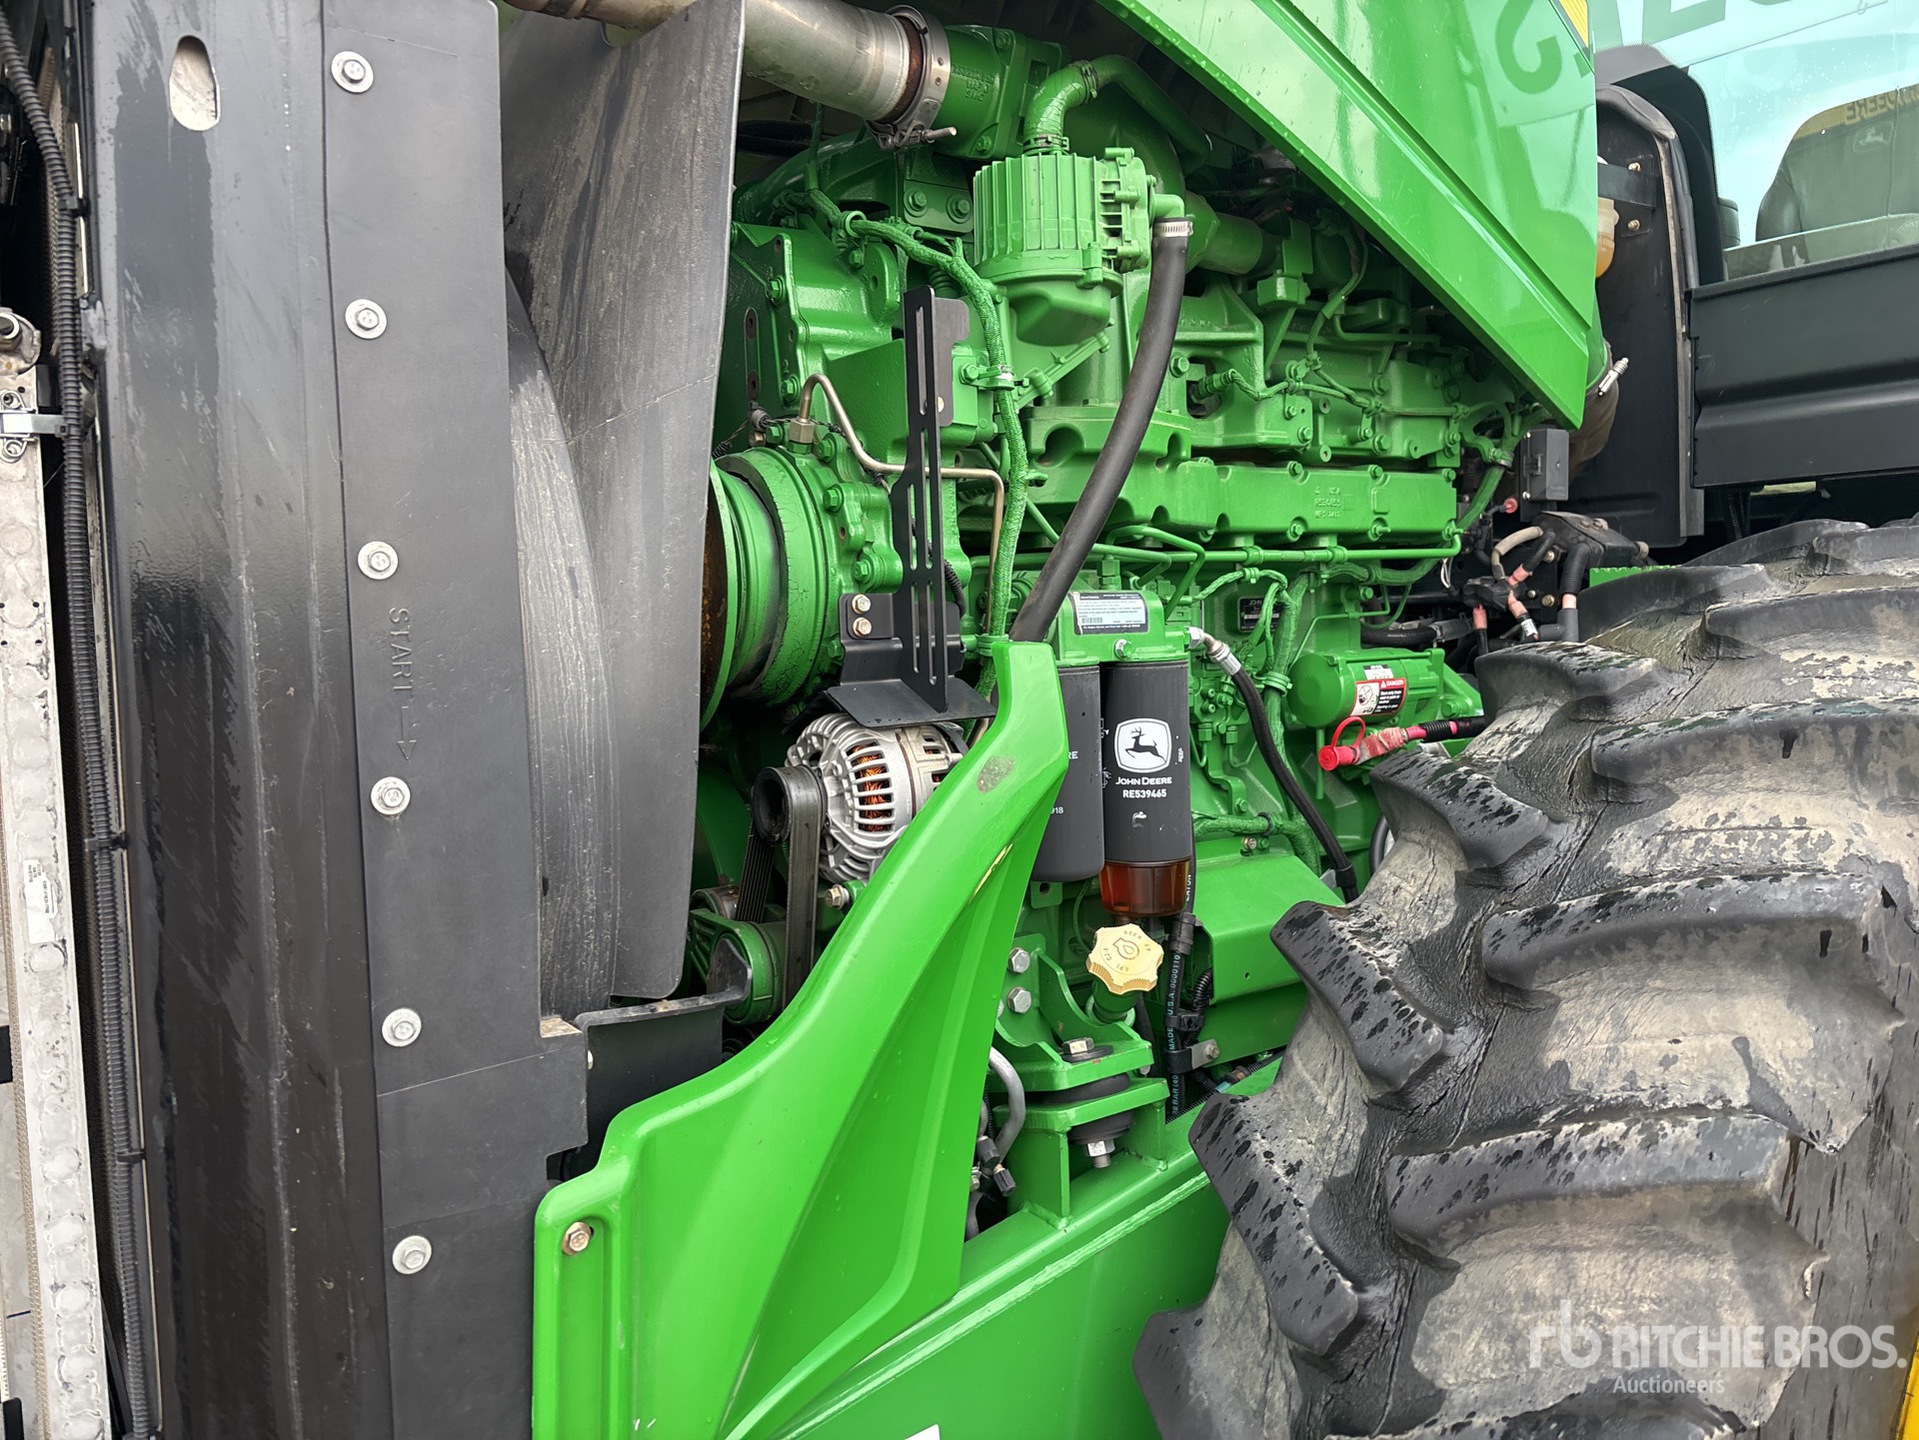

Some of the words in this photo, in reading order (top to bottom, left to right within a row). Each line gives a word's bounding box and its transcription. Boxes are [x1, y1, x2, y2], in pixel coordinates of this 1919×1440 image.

[388, 607, 415, 702] START
[1115, 776, 1141, 785] JOHN
[1141, 776, 1173, 786] DEERE
[1122, 788, 1167, 798] RE539465
[1167, 1027, 1176, 1050] MADE
